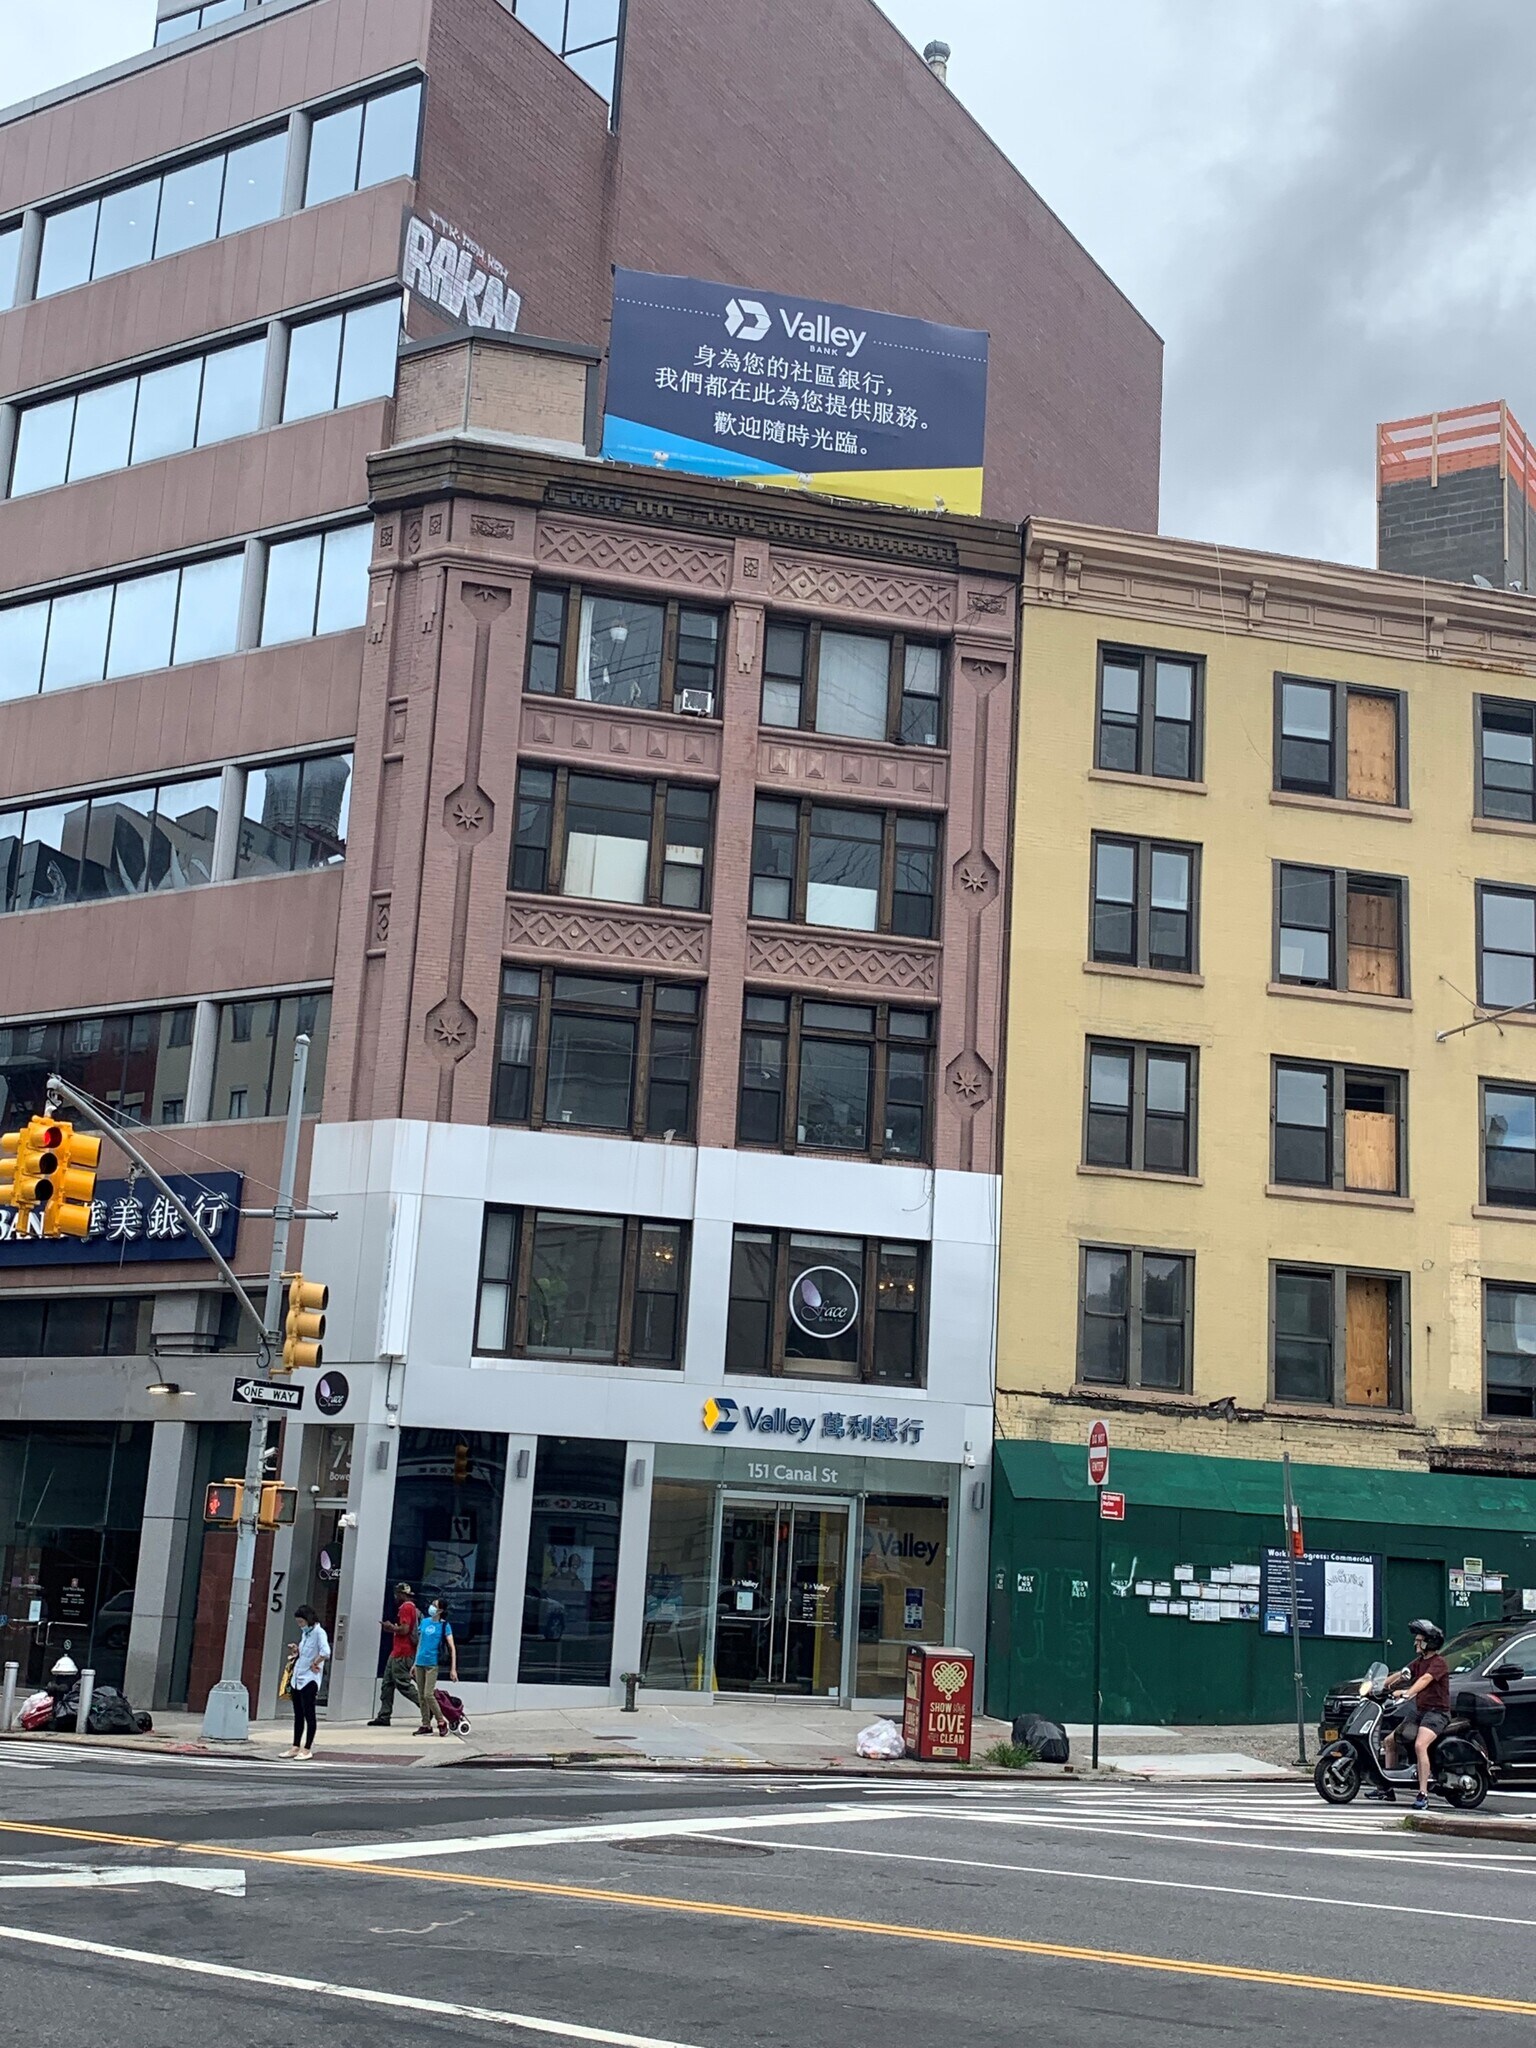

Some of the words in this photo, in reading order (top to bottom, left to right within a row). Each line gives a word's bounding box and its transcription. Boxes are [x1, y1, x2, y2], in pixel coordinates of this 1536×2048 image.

[779, 308, 867, 357] Valley
[809, 345, 838, 356] BANK
[654, 366, 932, 430] 我們都在此為您提供服務。
[712, 411, 868, 455] 歡迎隨時光臨。
[243, 1385, 265, 1398] ONE
[273, 1390, 295, 1402] WAY
[745, 1405, 816, 1443] Valley
[821, 1411, 925, 1445] 萬利銀行
[748, 1462, 770, 1479] 151
[773, 1465, 817, 1482] Canal
[821, 1467, 839, 1484] St
[877, 1531, 940, 1567] Valley
[1267, 1548, 1287, 1558] Work
[1330, 1553, 1373, 1563] Commercial
[929, 1702, 952, 1713] SHOW
[928, 1713, 966, 1734] LOVE
[939, 1733, 965, 1745] CLEAN
